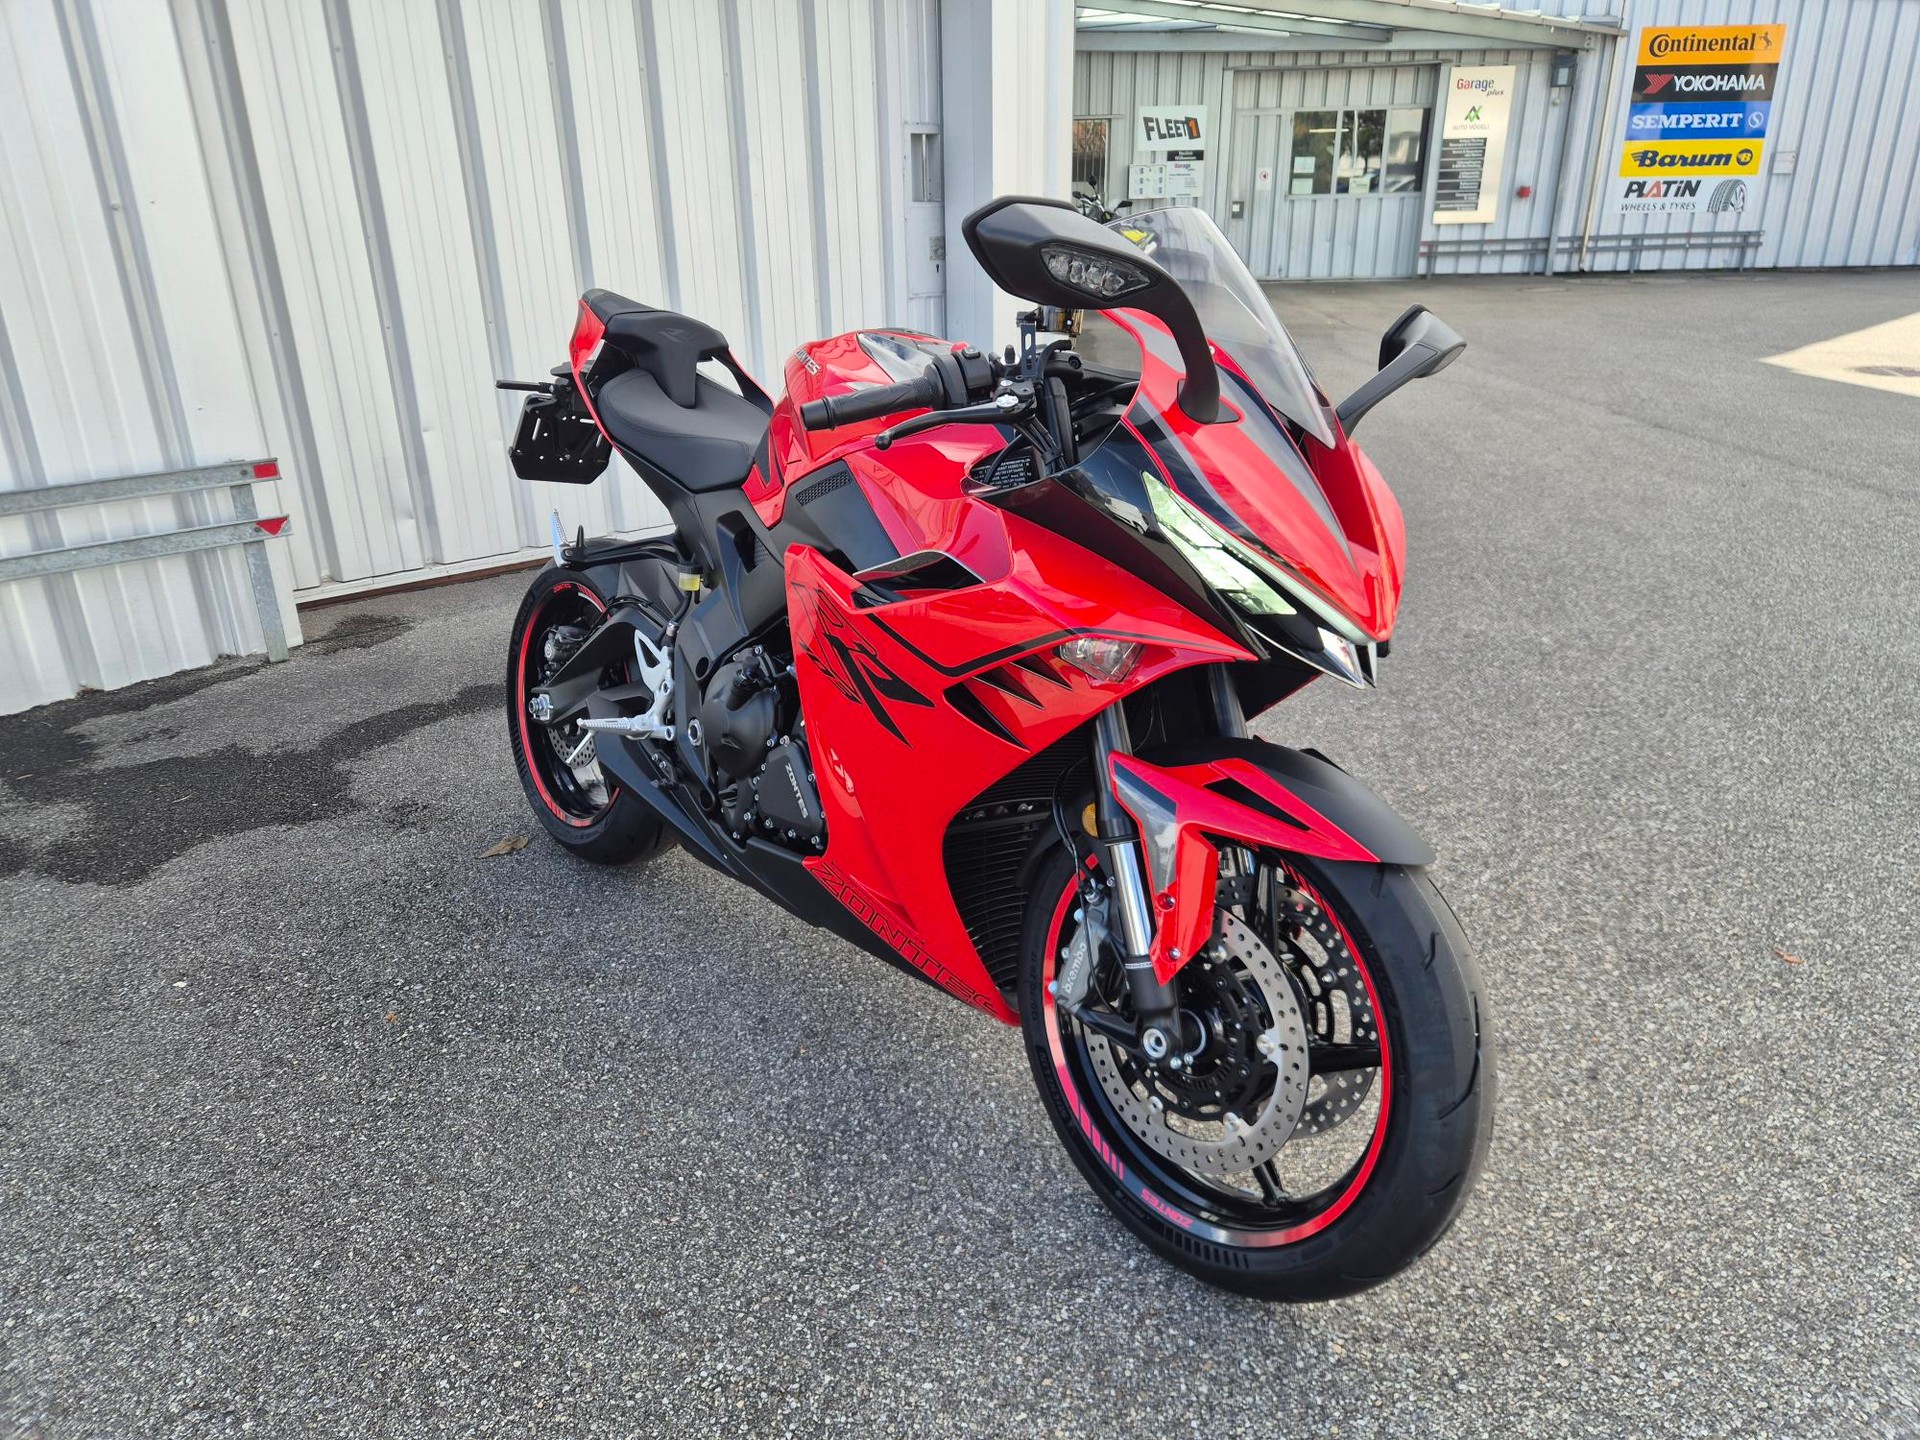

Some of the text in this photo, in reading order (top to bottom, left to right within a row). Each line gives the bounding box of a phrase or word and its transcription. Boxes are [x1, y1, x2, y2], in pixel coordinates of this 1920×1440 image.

[1649, 32, 1757, 58] Continental
[1456, 78, 1495, 92] Garage
[1673, 74, 1766, 92] YOKOHAMA
[1631, 112, 1743, 130] SEMPERIT
[1630, 149, 1733, 168] Barum
[1620, 201, 1697, 211] WHEELS & TYRES
[785, 762, 809, 819] ZONTES
[811, 861, 999, 1016] ZONTES
[1062, 943, 1087, 994] brembo
[1140, 1187, 1194, 1228] ZONTES
